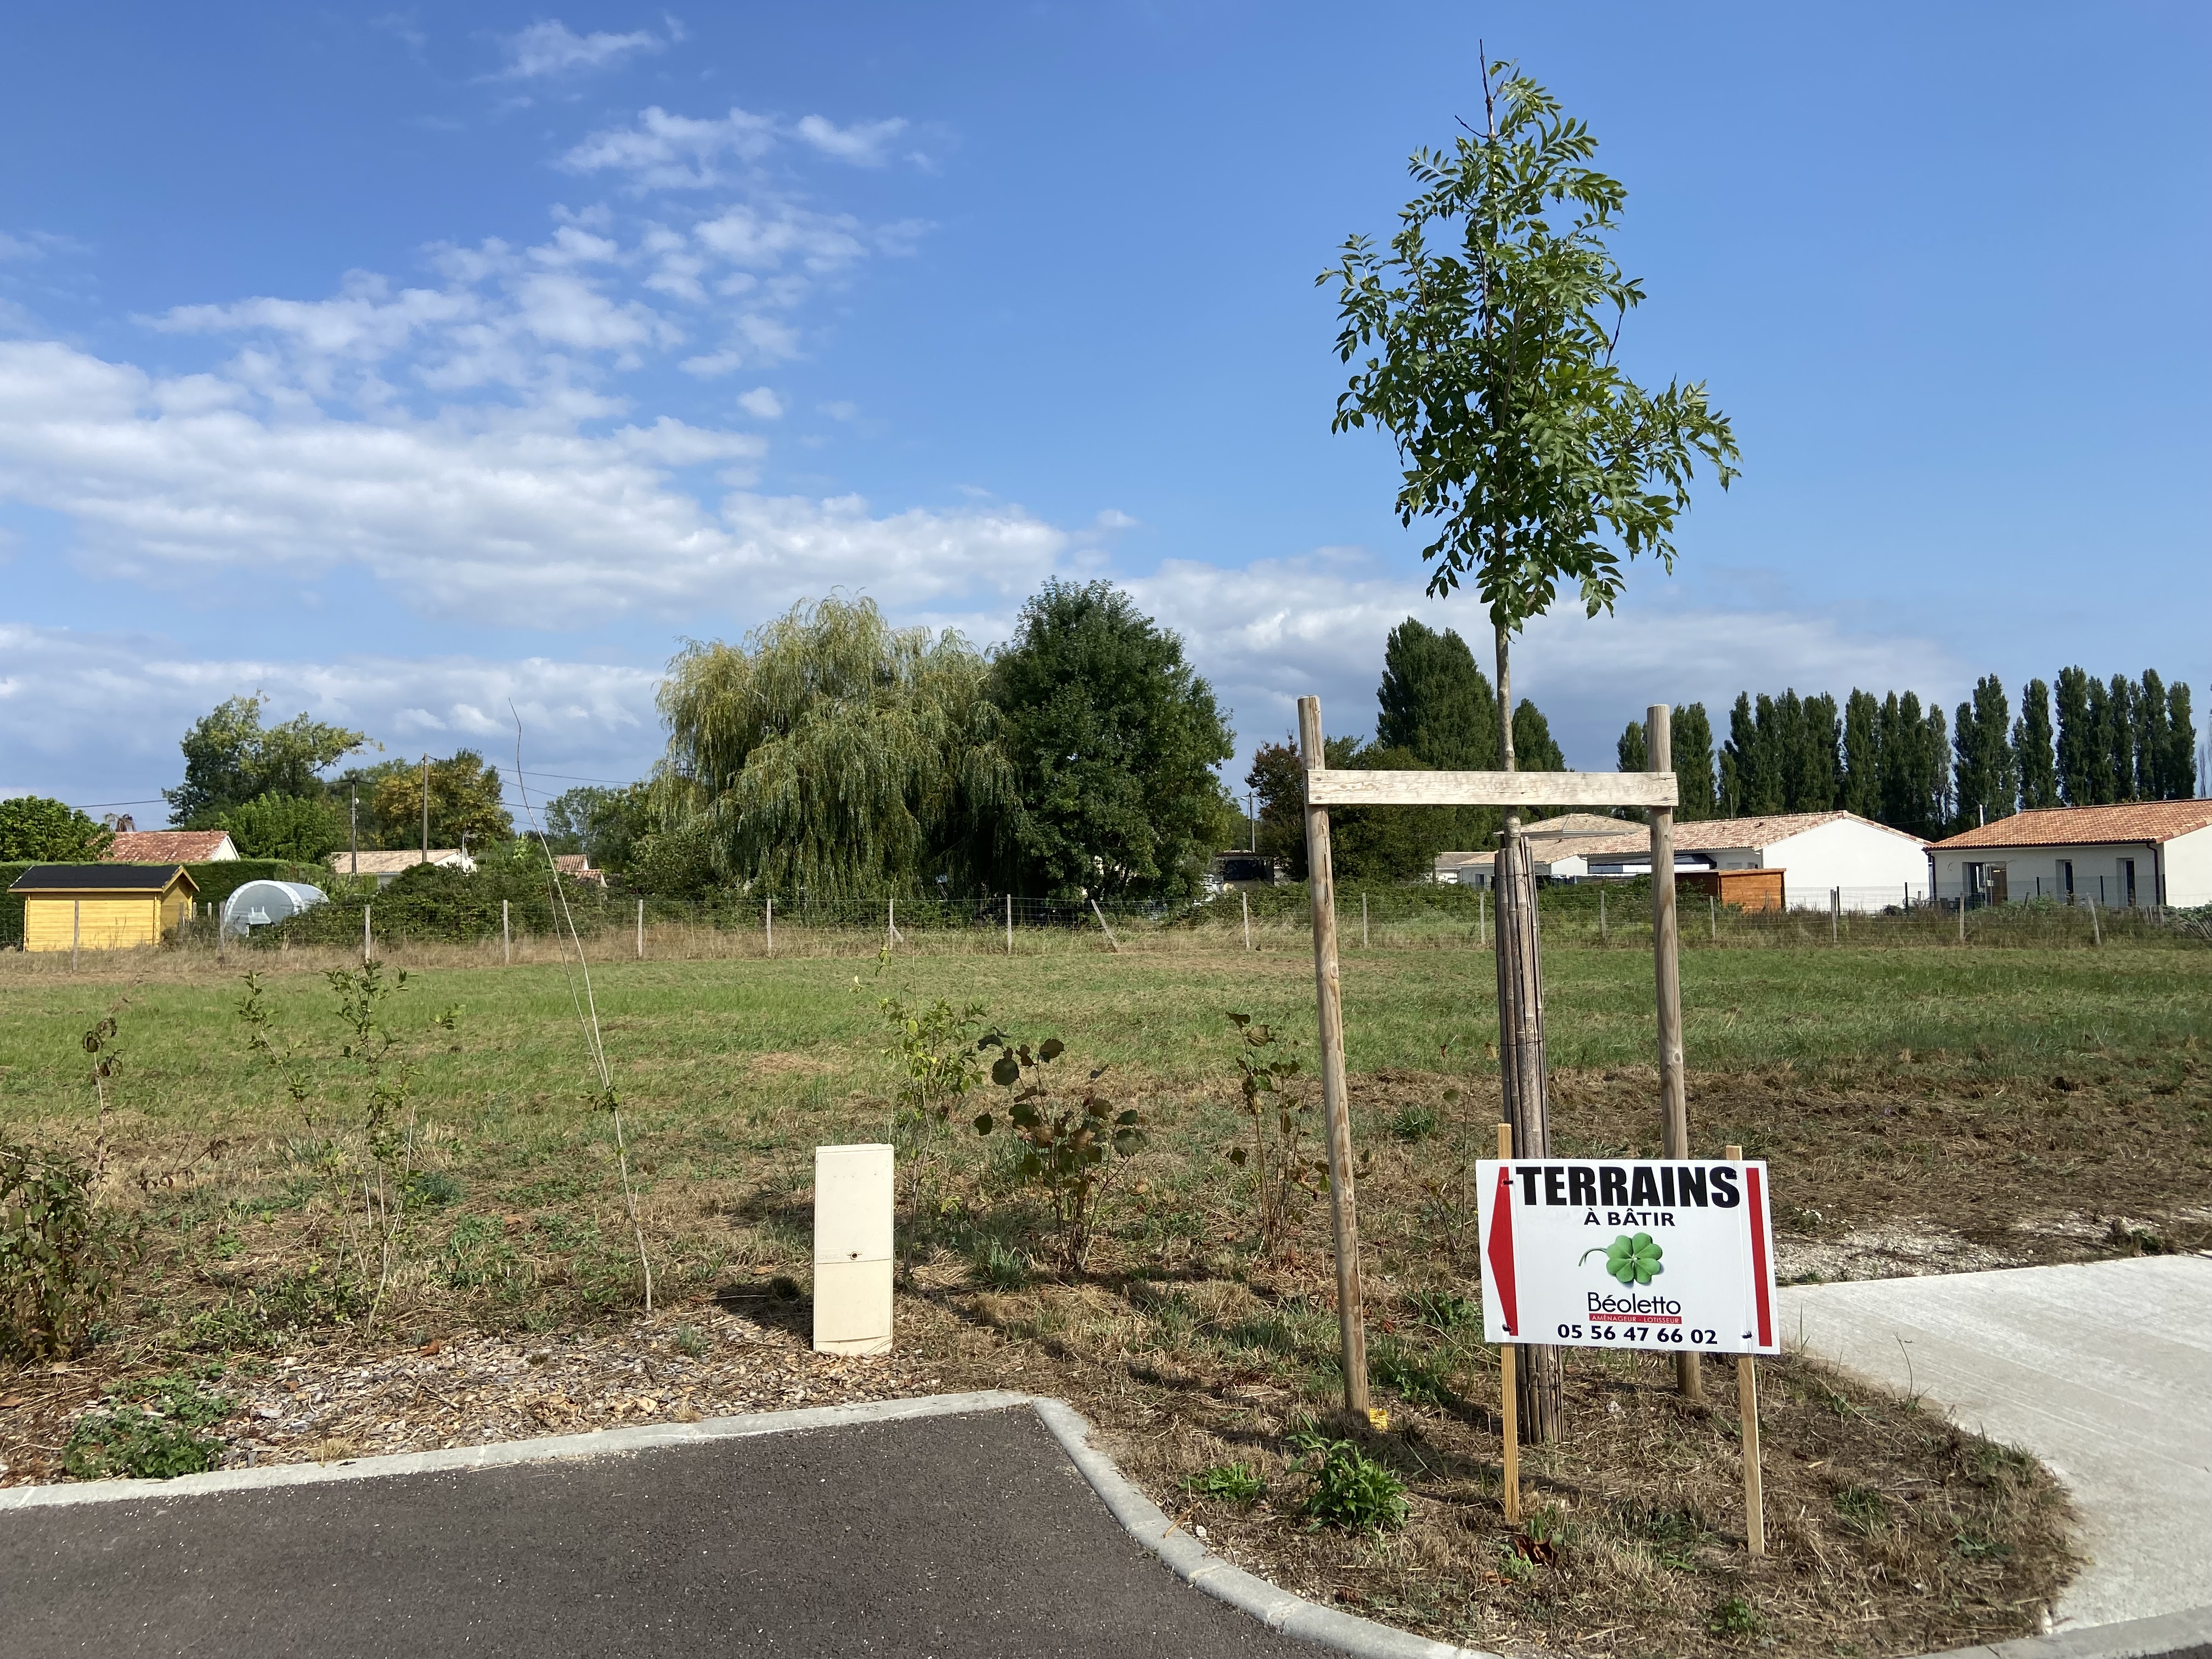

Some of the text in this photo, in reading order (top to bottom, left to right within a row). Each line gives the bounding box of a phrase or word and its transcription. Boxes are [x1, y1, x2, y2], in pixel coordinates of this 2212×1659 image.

[1516, 1166, 1740, 1208] TERRAINS
[1584, 1207, 1675, 1226] À BÂTIR
[1588, 1292, 1681, 1314] Béoletto
[1558, 1324, 1718, 1345] 05 56 47 66 02
